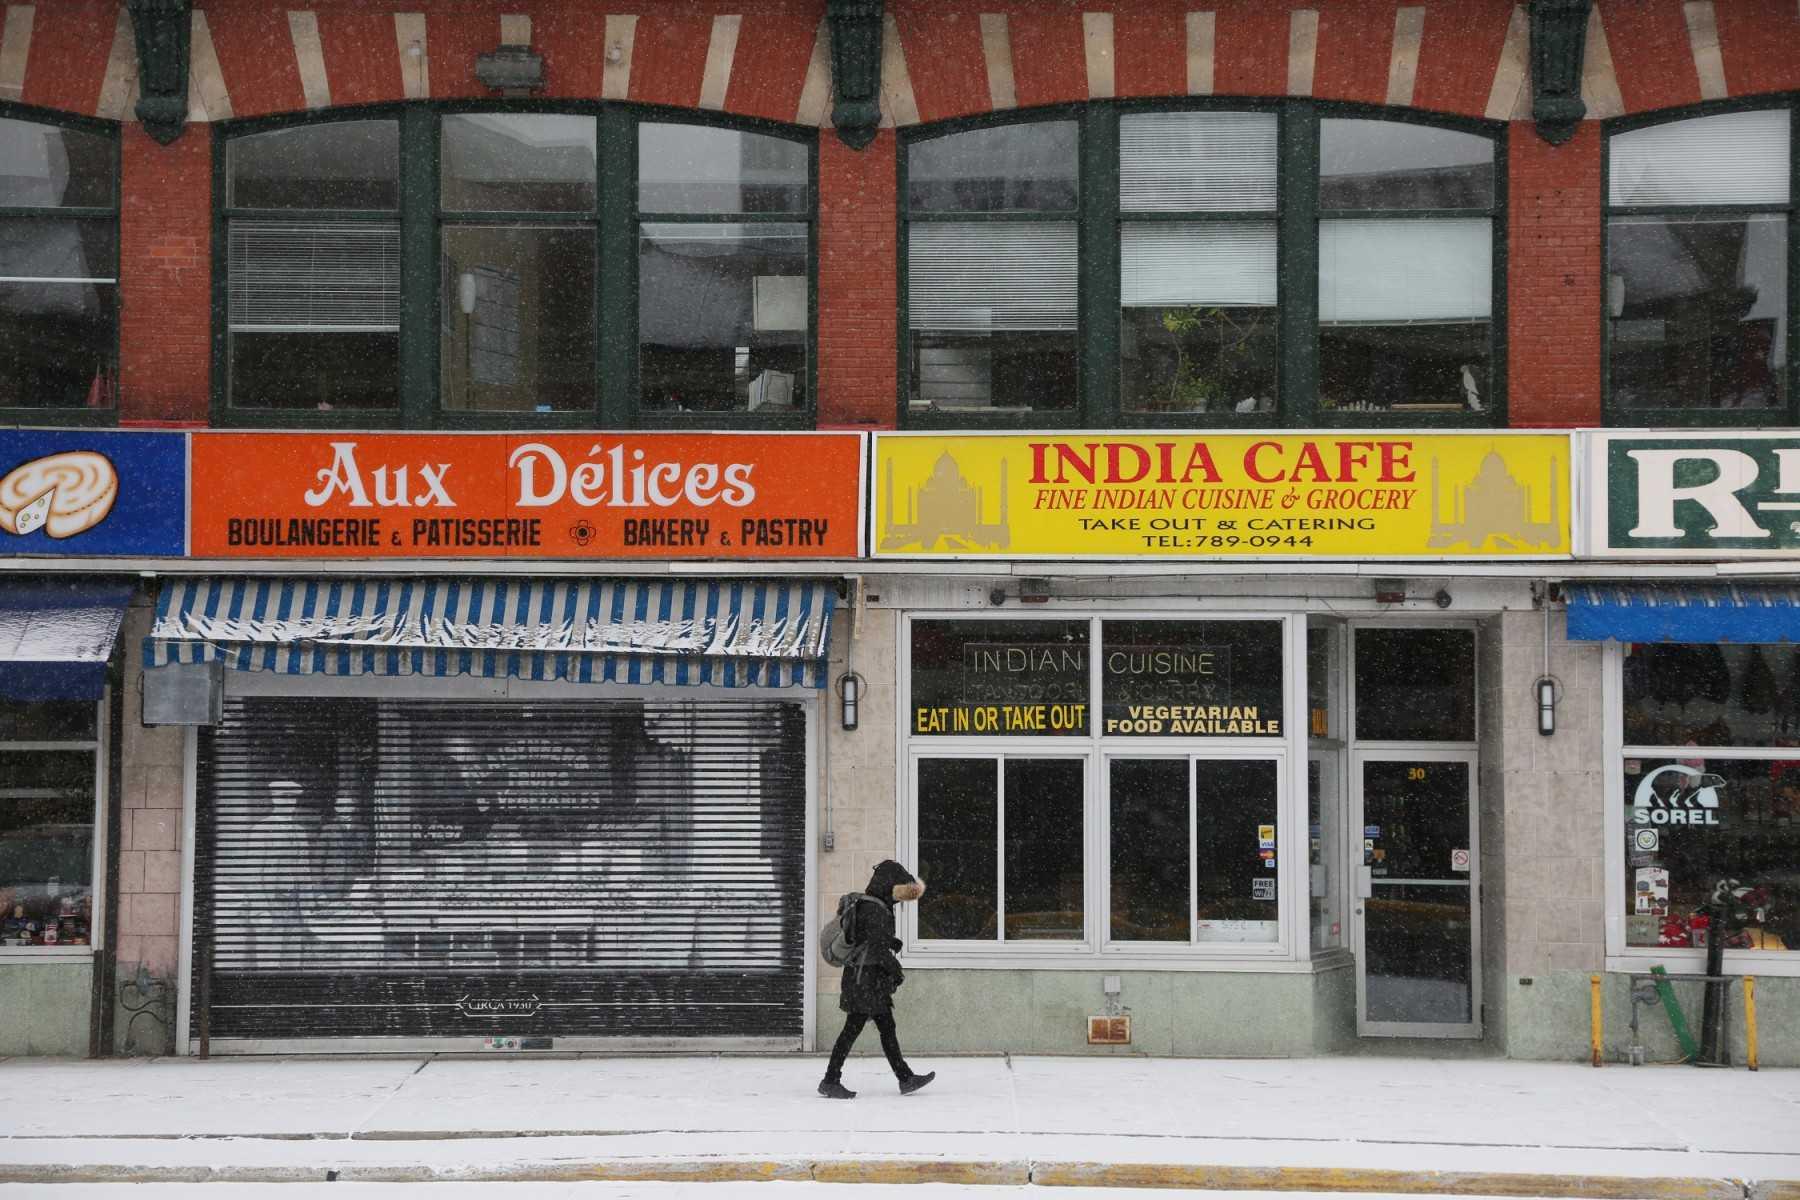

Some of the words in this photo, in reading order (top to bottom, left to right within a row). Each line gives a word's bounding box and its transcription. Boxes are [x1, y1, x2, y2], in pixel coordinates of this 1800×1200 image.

[1028, 442, 1223, 484] INDIA
[1243, 441, 1417, 484] CAFE
[304, 442, 457, 507] Aux
[509, 442, 756, 507] Délices
[1033, 488, 1087, 510] FINE
[1093, 488, 1177, 510] INDIAN
[1182, 487, 1275, 510] CUISINE
[1281, 486, 1300, 510] &
[1307, 488, 1417, 510] GROCERY
[227, 517, 380, 547] BOULANGERIE
[391, 531, 403, 547] &
[412, 518, 542, 547] PATISSERIE
[623, 518, 710, 547] BAKERY
[719, 531, 732, 547] &
[740, 518, 829, 547] PASTRY
[1078, 518, 1140, 531] TAKE
[1149, 518, 1207, 531] OUT
[1217, 519, 1238, 531] &
[1246, 518, 1377, 531] CATERING
[973, 648, 1081, 673] INDIAN
[1108, 651, 1216, 675] CUISINE
[917, 707, 949, 732] EAT
[953, 708, 969, 731] IN
[974, 706, 999, 731] OR
[1003, 705, 1047, 730] TAKE
[1050, 705, 1086, 729] OUT
[1128, 706, 1258, 720] VEGETARIAN
[1107, 719, 1163, 733] FOOD
[1170, 719, 1280, 733] AVAILABLE
[1407, 767, 1425, 780] 30
[1634, 808, 1719, 825] SOREL
[1254, 880, 1273, 888] FREE
[468, 998, 505, 1010] CIRCA
